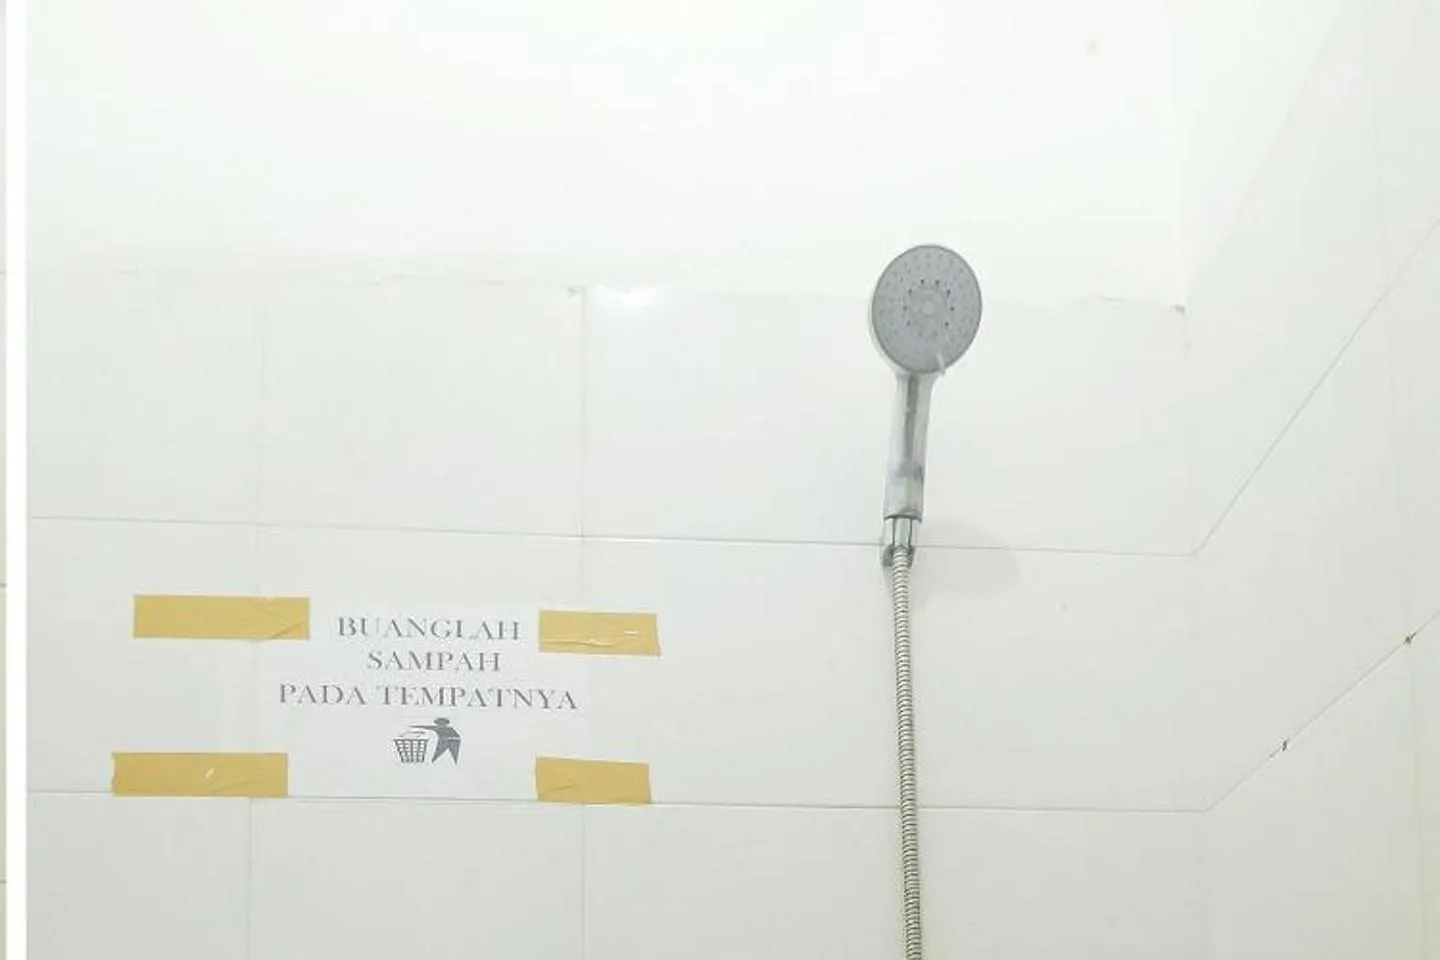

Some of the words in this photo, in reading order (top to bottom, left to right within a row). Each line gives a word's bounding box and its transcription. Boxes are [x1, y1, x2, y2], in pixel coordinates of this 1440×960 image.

[338, 616, 520, 641] BUANGLAH
[366, 650, 500, 673] SAMPAH
[279, 683, 367, 706] PADA
[376, 685, 578, 711] TEMPATNYA
